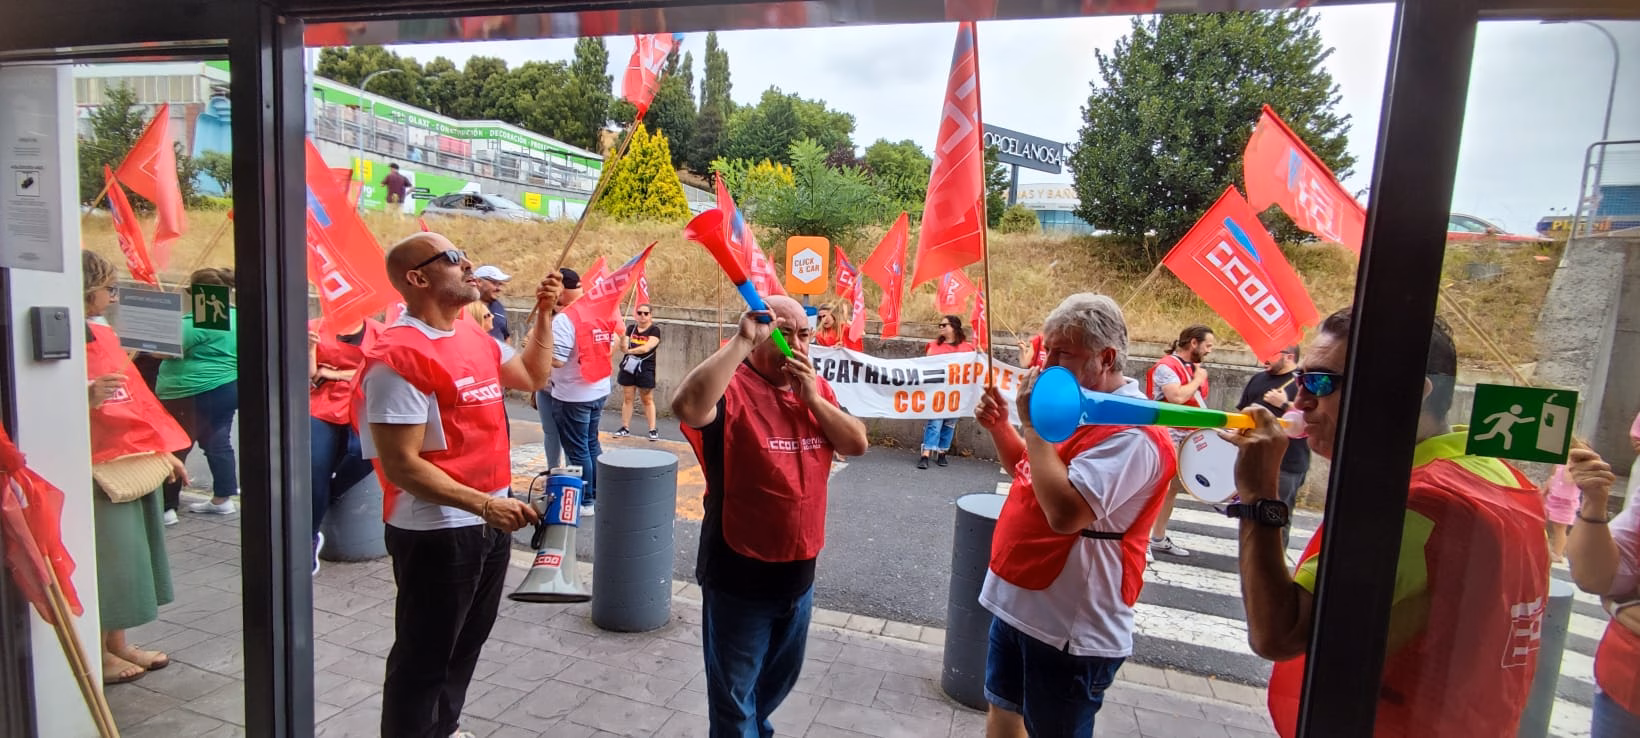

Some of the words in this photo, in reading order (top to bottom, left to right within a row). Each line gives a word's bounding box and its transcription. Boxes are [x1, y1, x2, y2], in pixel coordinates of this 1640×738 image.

[983, 131, 1062, 166] ORCELANOSA
[794, 257, 815, 267] CLICK
[806, 264, 820, 273] CAR
[1205, 240, 1285, 324] CCOO
[812, 357, 920, 387] ECATHLON
[769, 440, 800, 450] CCOO
